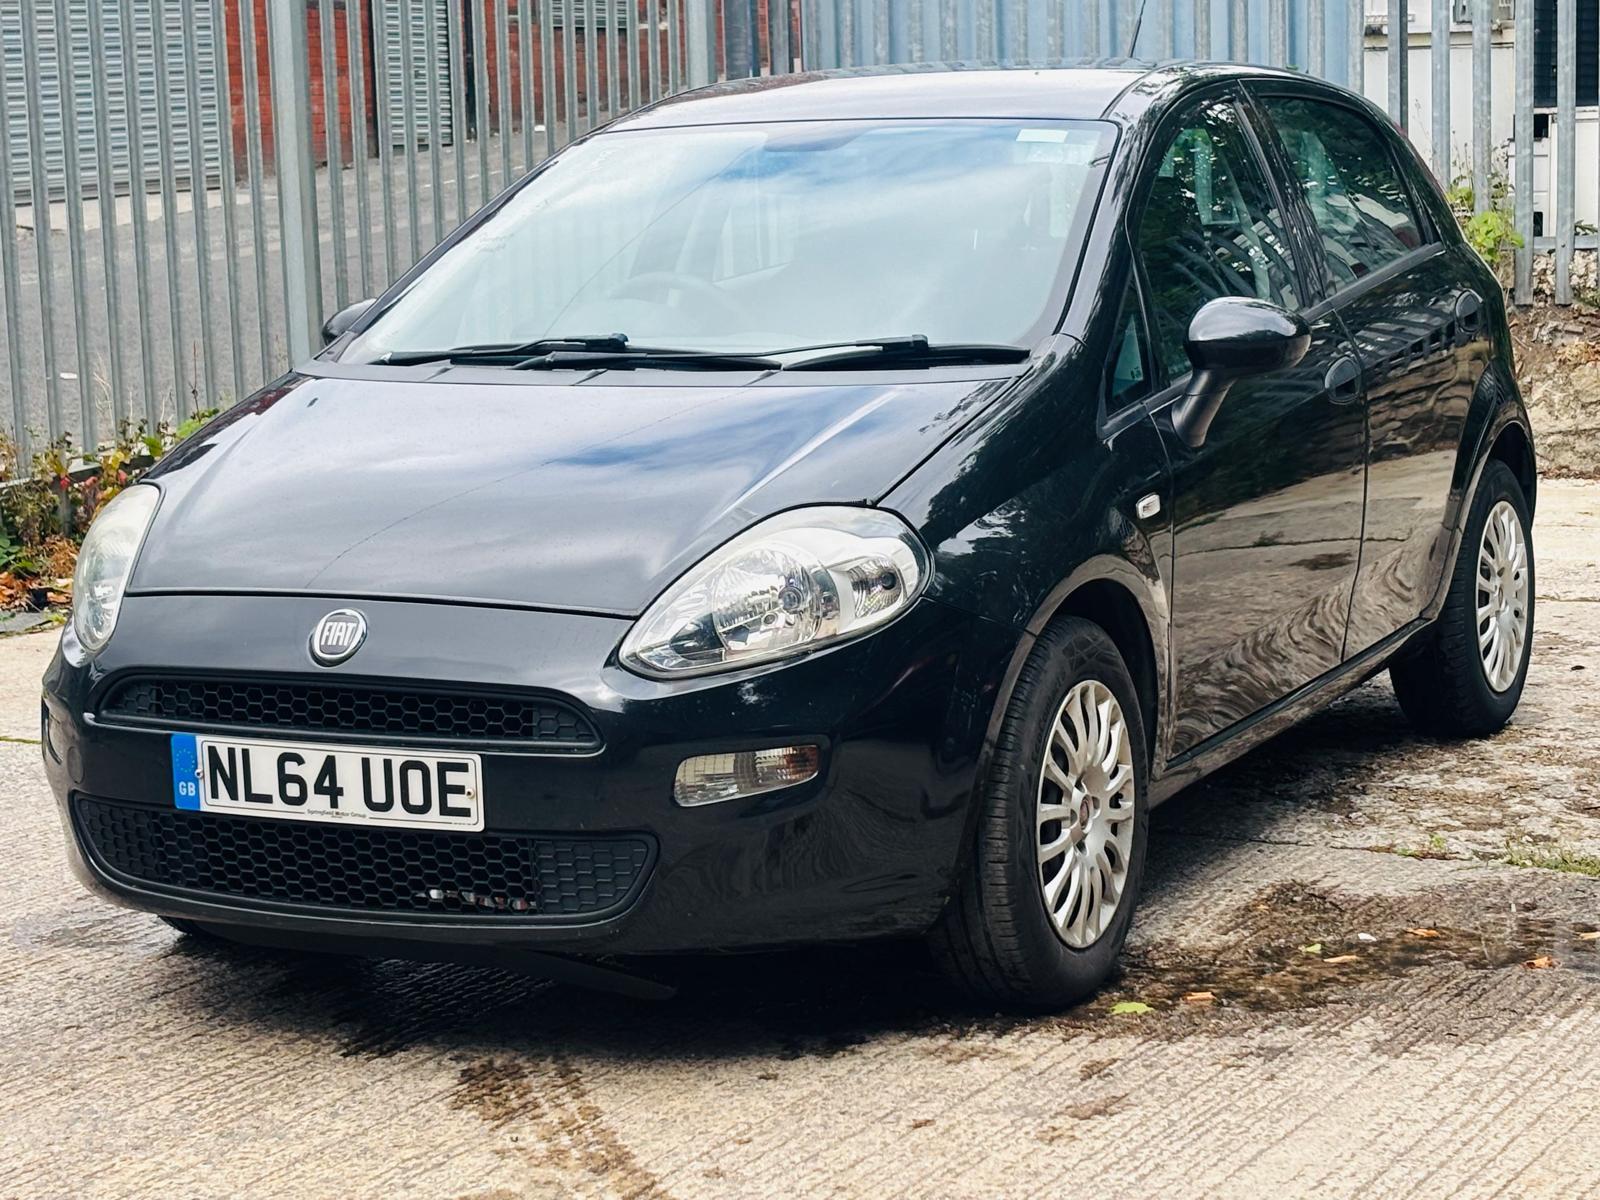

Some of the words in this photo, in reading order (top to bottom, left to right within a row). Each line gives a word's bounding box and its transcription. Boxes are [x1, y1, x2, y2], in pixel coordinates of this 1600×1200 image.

[320, 621, 357, 646] FIAT
[179, 781, 196, 796] GB
[207, 745, 344, 809] NL64
[361, 756, 472, 818] UOE
